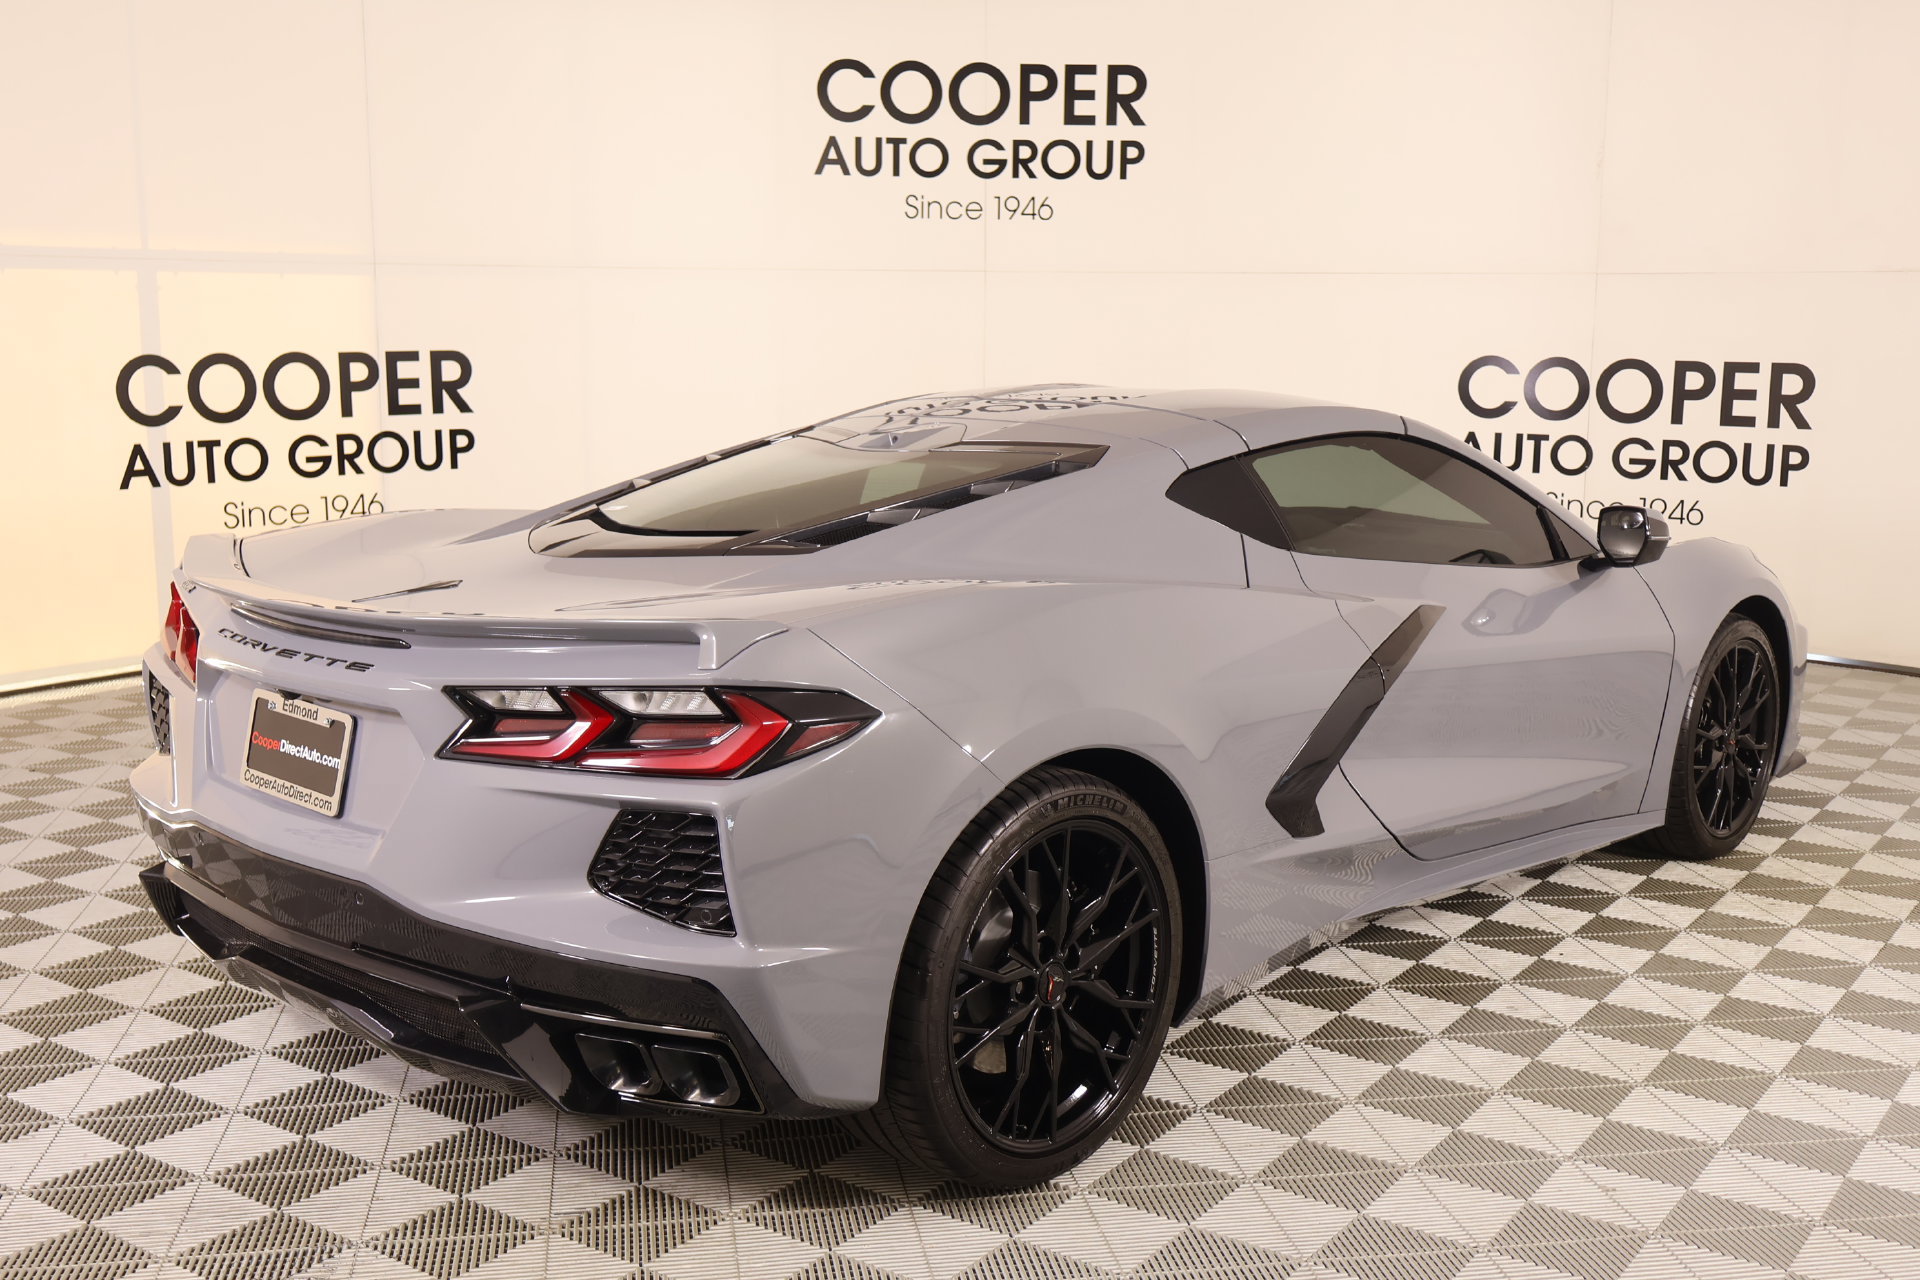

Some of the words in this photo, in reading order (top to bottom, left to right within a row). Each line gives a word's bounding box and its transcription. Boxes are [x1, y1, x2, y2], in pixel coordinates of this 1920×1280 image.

[817, 58, 1147, 126] COOPER
[814, 135, 949, 178] AUTO
[967, 138, 1145, 180] GROUP
[904, 194, 983, 220] Since
[994, 195, 1054, 221] 1946
[116, 350, 474, 427] COOPER
[1458, 355, 1816, 430] COOPER
[119, 437, 269, 490] AUTO
[288, 429, 475, 478] GROUP
[1612, 437, 1810, 487] GROUP
[223, 501, 310, 530] Since
[320, 492, 384, 521] 1946
[1546, 491, 1624, 520] inc
[218, 627, 375, 672] CORVETTE
[282, 698, 320, 721] Edmond
[251, 731, 341, 770] CooperDirectAuto.com
[243, 768, 332, 812] CooperAutoDirect.com
[1057, 793, 1127, 815] MICHELIN
